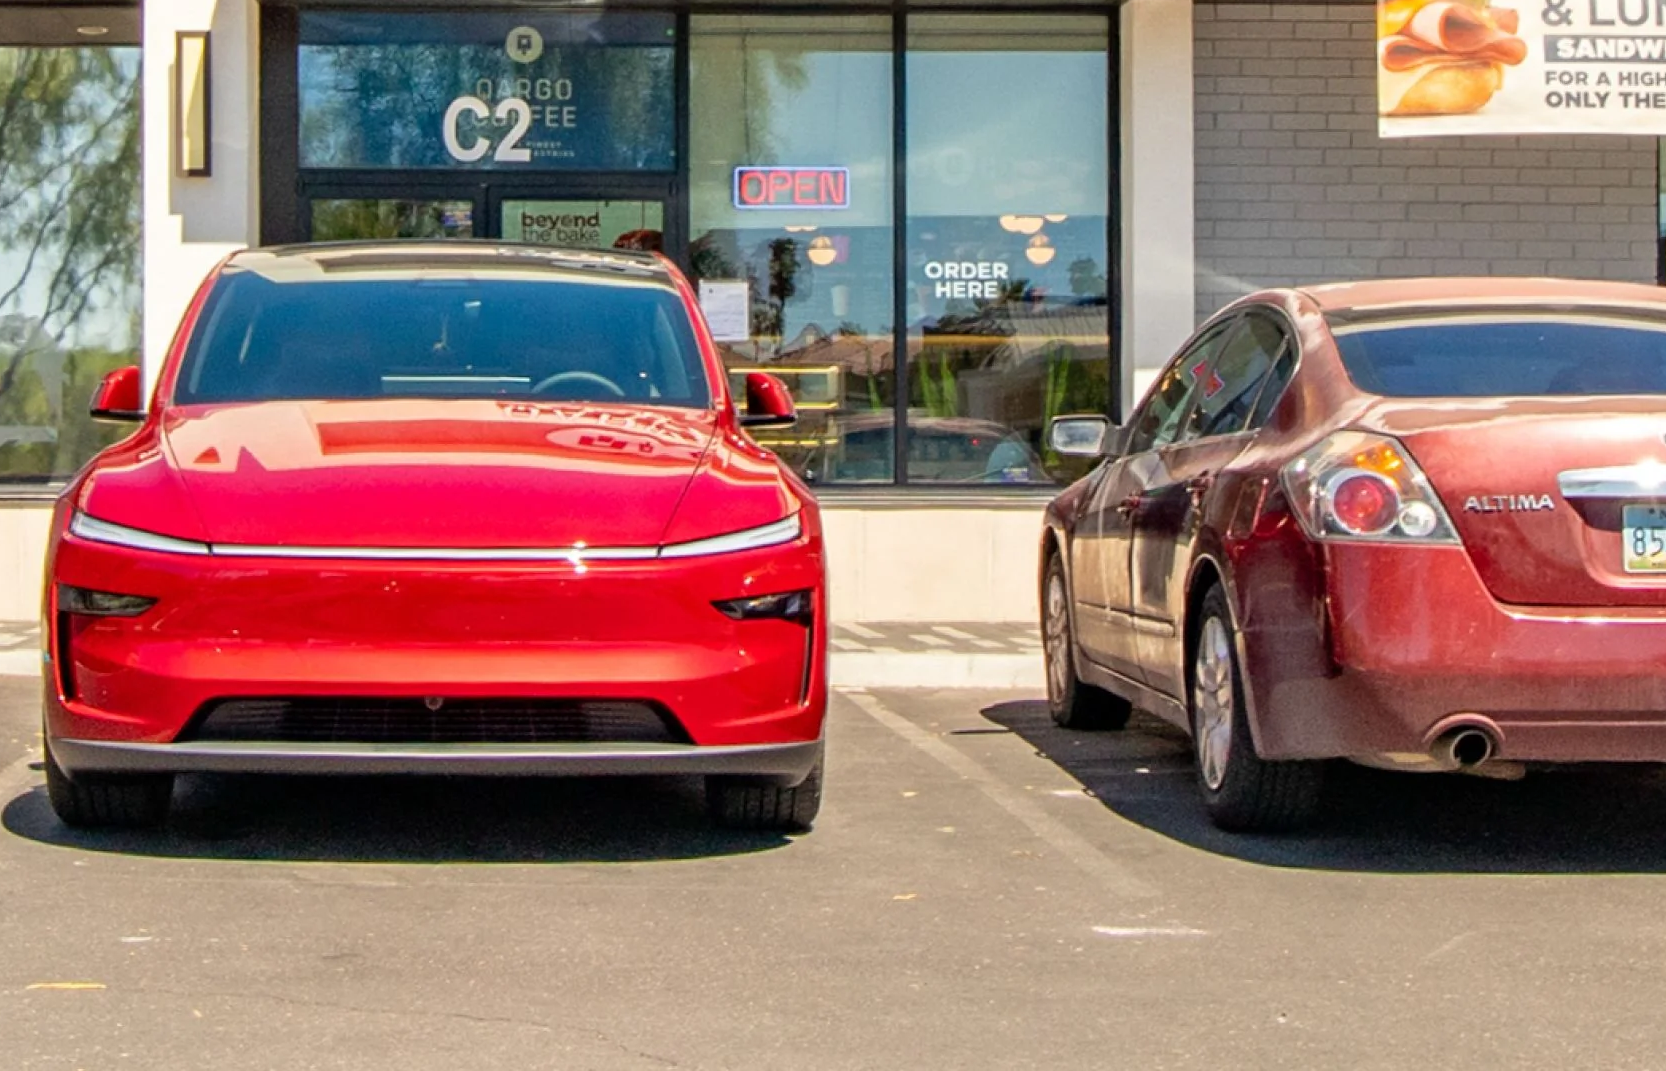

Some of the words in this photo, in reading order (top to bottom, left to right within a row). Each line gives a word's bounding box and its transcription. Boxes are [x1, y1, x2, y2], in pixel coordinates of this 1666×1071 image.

[1544, 71, 1588, 86] FOR
[1595, 71, 1612, 86] A
[1545, 91, 1610, 108] ONLY
[1618, 91, 1666, 109] THE
[443, 95, 532, 162] C2
[739, 171, 845, 204] OPEN
[520, 210, 601, 229] beyond
[522, 227, 551, 242] the
[557, 227, 601, 242] bake
[924, 261, 1009, 280] ORDER
[935, 280, 999, 299] HERE
[1463, 494, 1555, 512] ALTIMA
